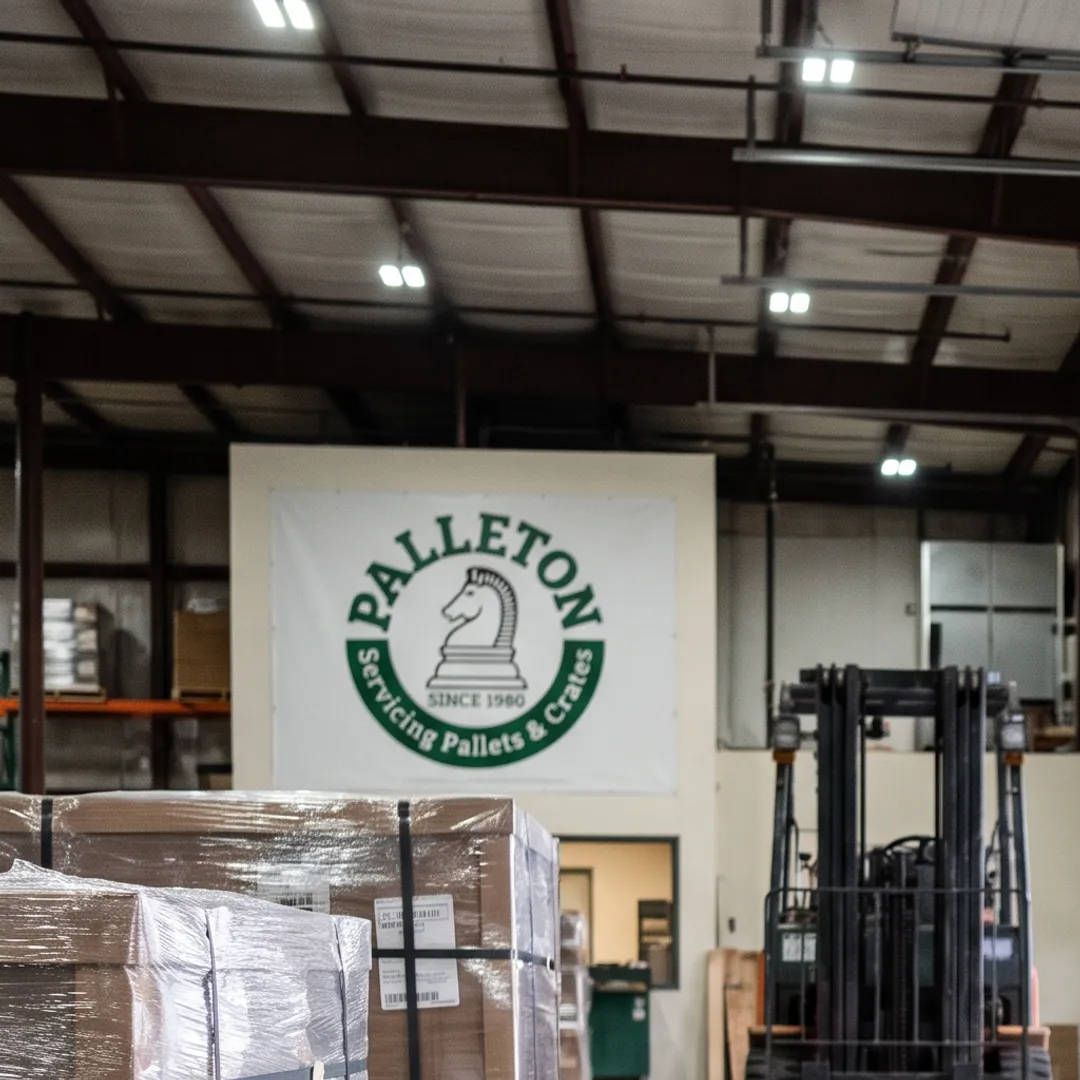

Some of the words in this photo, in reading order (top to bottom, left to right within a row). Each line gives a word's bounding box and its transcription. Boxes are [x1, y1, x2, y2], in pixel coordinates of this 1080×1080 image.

[348, 512, 603, 632] PALLETON
[358, 647, 438, 751] Servicing
[440, 731, 525, 757] Pallets
[525, 720, 548, 741] &
[544, 648, 593, 725] Crates
[427, 693, 481, 708] SINCE
